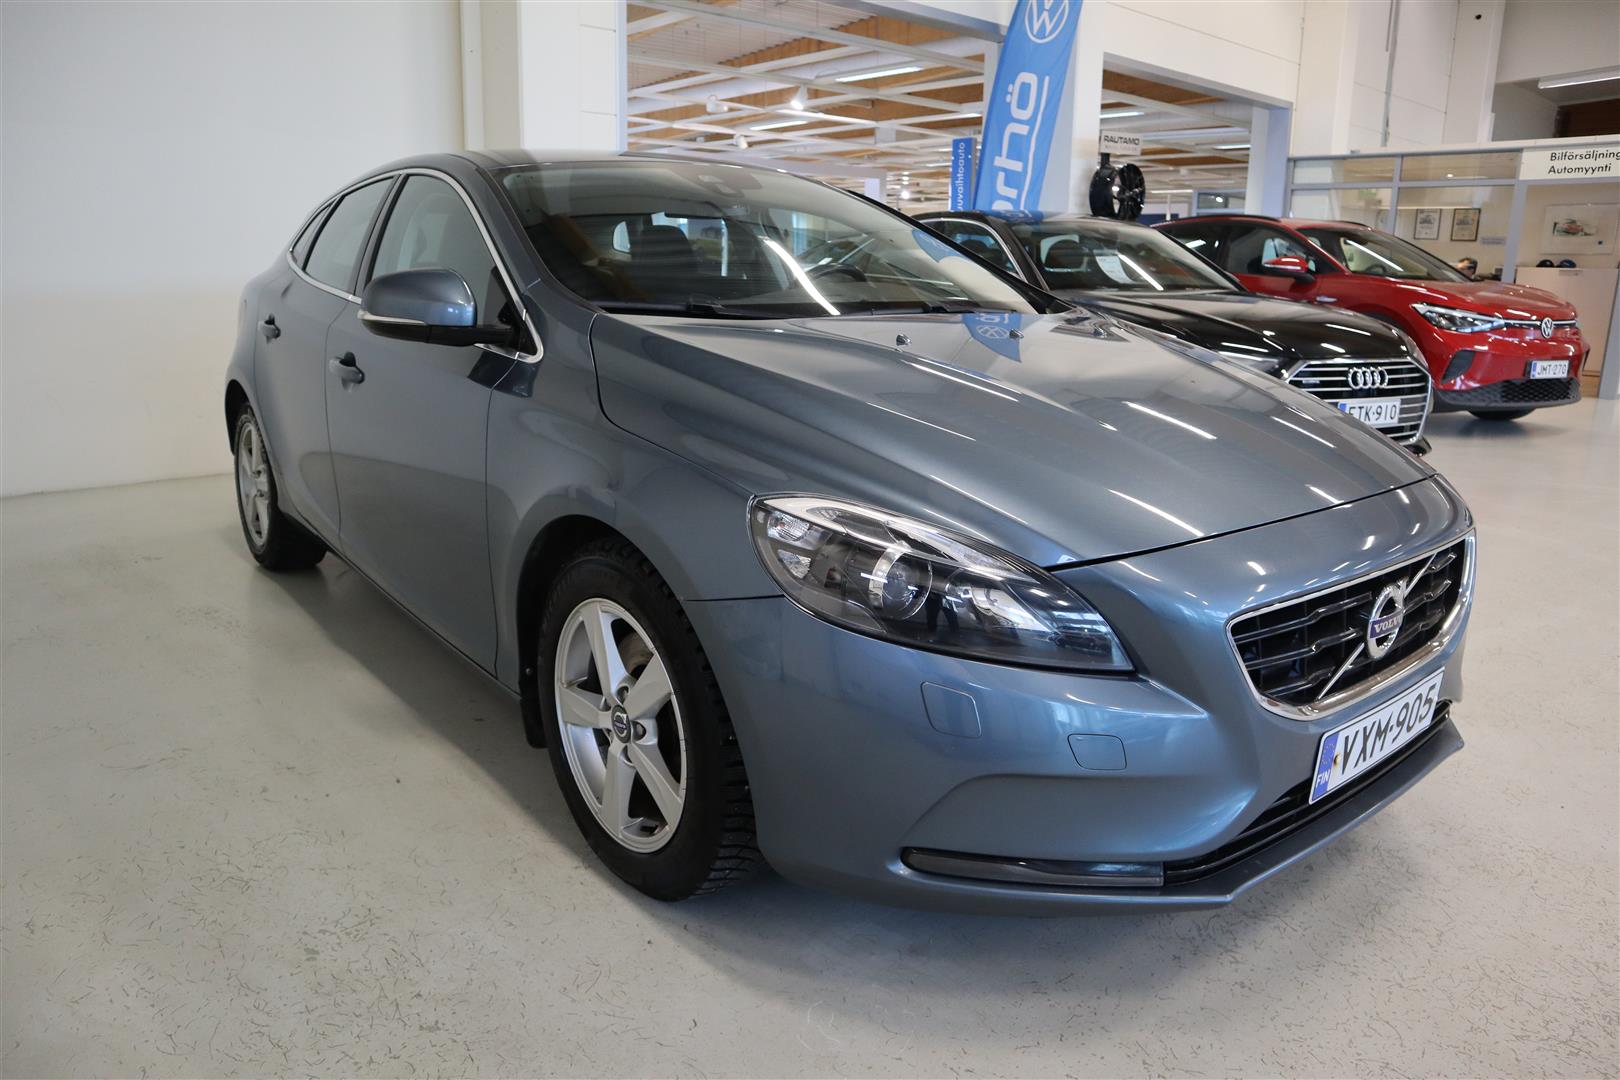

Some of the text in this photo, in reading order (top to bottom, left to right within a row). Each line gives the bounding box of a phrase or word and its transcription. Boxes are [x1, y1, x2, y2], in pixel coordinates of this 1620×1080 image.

[992, 71, 1038, 210] rhö
[1103, 135, 1140, 146] RAUTAMO
[1550, 149, 1620, 162] Bilförsäljning
[1548, 163, 1612, 175] Automyynti
[1341, 684, 1437, 775] VXM-905
[1316, 769, 1331, 788] FIN
